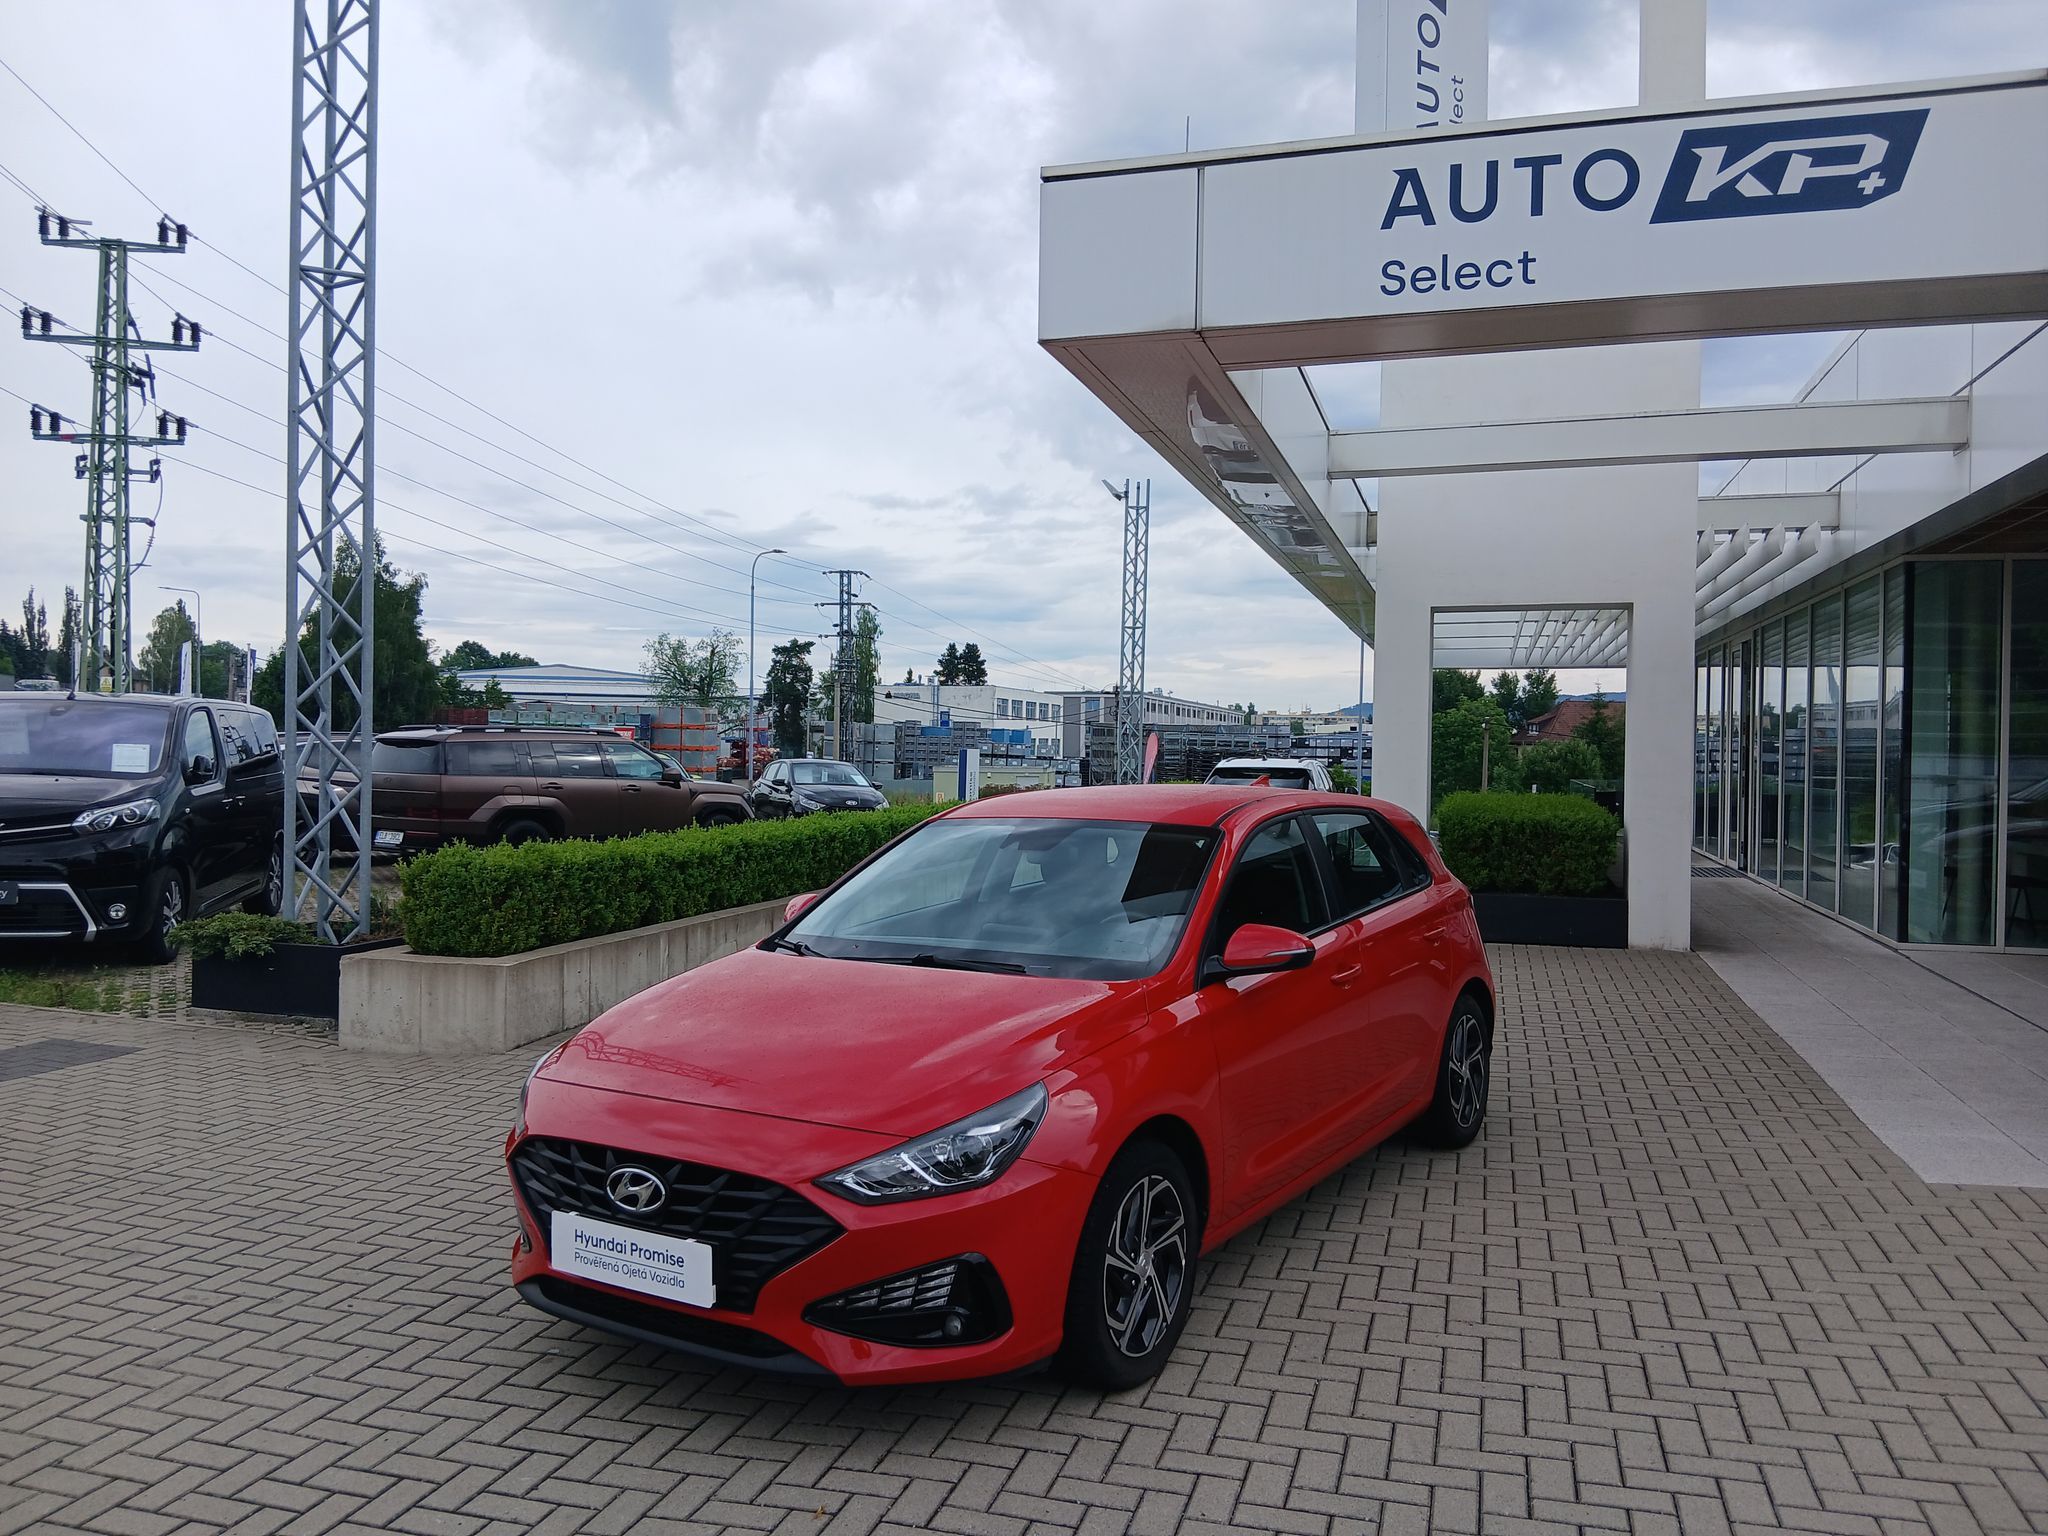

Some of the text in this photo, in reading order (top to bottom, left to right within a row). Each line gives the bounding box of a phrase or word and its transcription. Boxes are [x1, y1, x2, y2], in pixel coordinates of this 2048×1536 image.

[1416, 12, 1440, 129] UTO
[1448, 74, 1464, 125] lect
[1380, 148, 1641, 230] AUTO
[1380, 251, 1537, 296] Select
[574, 1228, 685, 1268] Hyundai Promise
[574, 1251, 685, 1289] Prověřená Ojetá Vozidla
